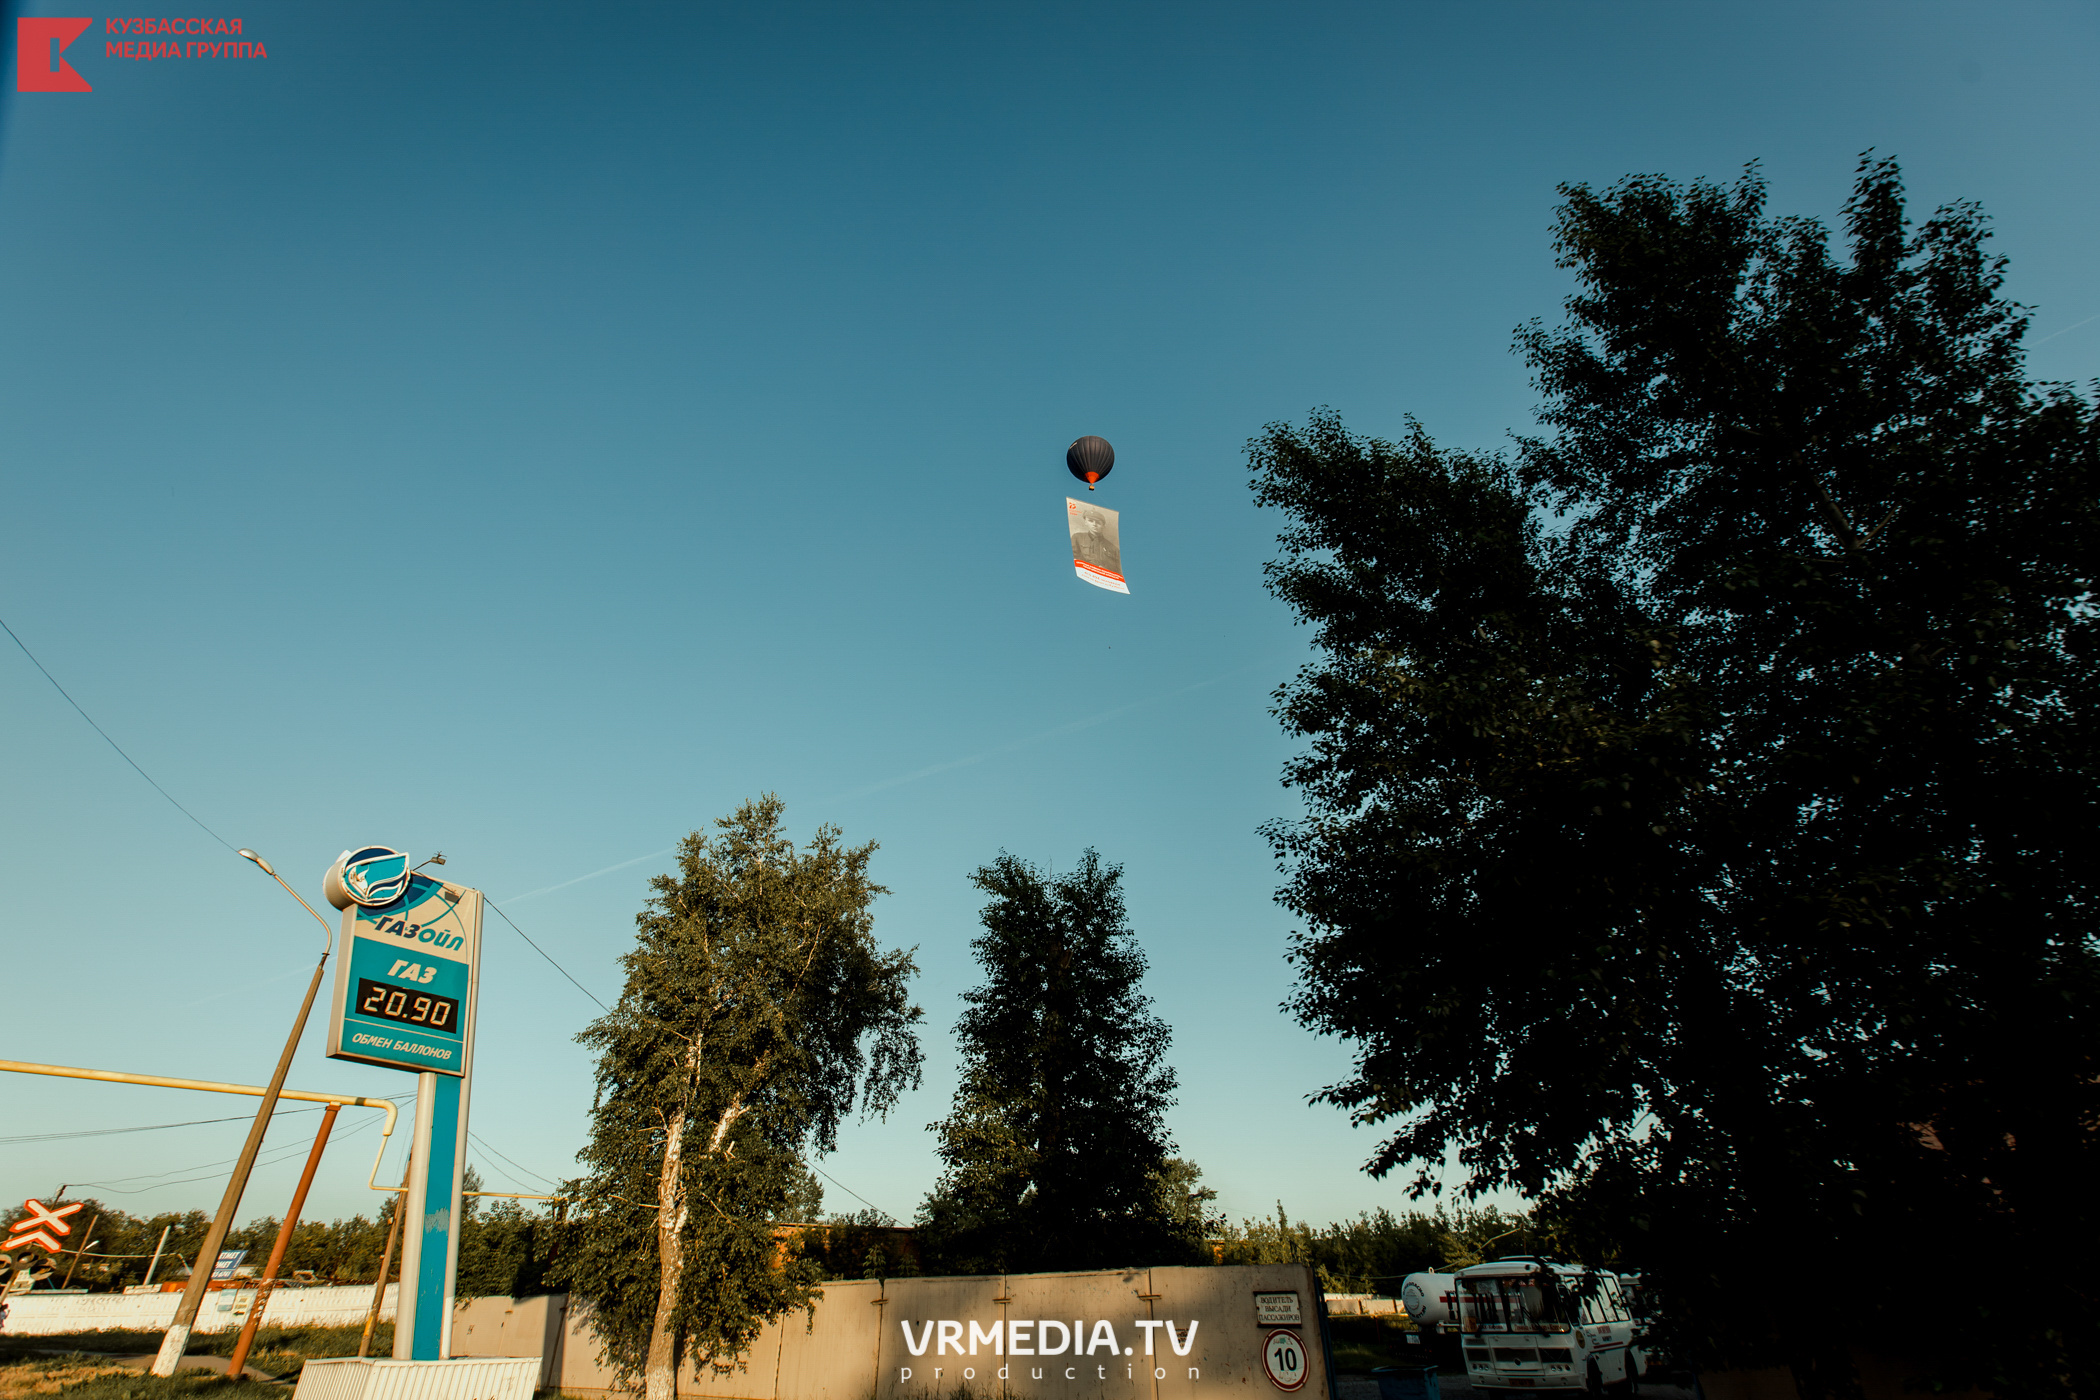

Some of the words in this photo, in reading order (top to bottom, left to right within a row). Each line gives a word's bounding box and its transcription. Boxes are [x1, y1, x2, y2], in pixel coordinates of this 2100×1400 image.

[387, 959, 438, 984] ГАЗ
[363, 986, 452, 1026] 20.90
[352, 1032, 393, 1049] ОБМЕН
[393, 1040, 453, 1060] БАЛЛОНОВ
[1260, 1296, 1293, 1304] ВОДИТЕЛЬ
[1274, 1347, 1297, 1371] 10
